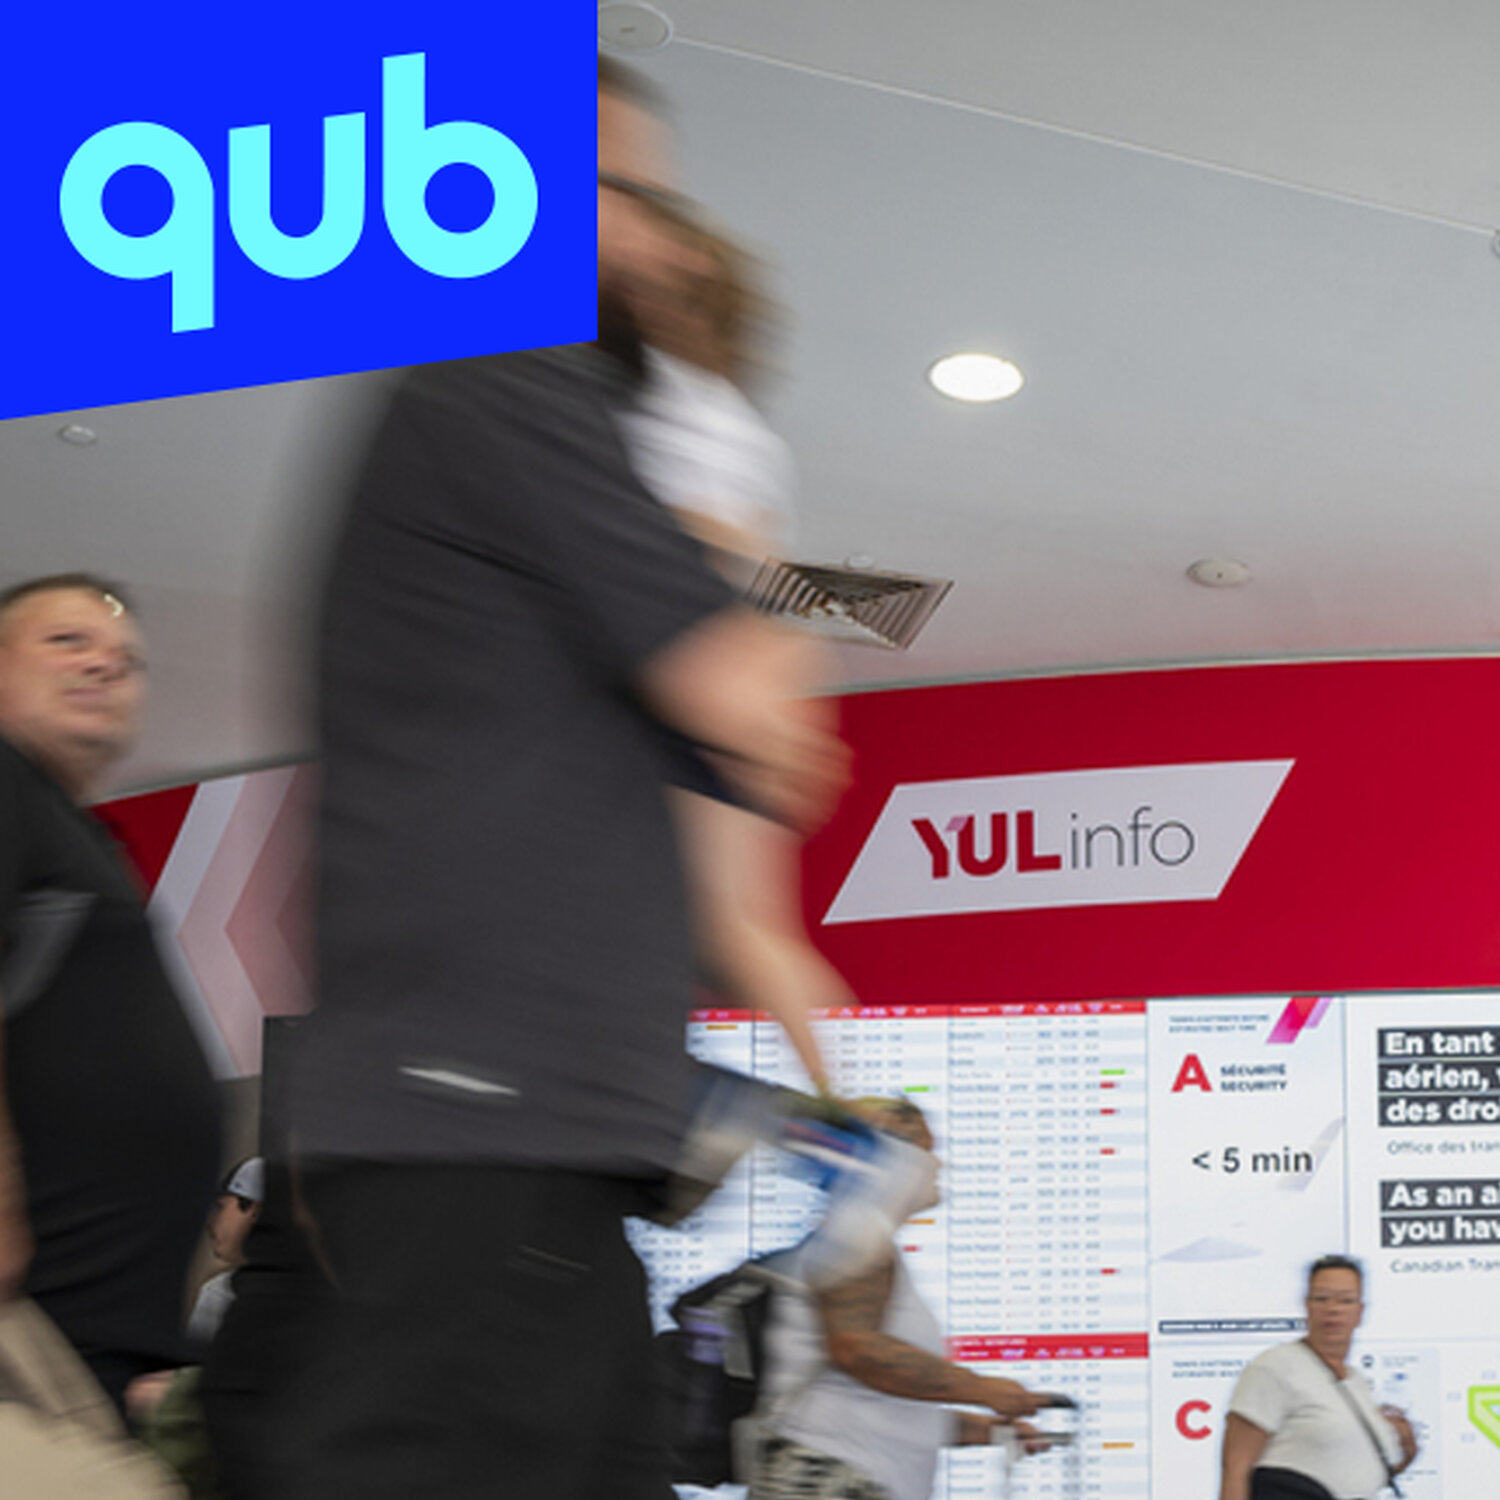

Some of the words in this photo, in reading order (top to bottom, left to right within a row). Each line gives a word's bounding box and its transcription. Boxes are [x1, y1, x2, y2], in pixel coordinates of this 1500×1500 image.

[1384, 1032, 1424, 1055] En
[1432, 1031, 1495, 1054] tant
[1171, 1054, 1213, 1093] A
[1385, 1066, 1489, 1092] aérien,
[1386, 1099, 1441, 1122] des
[1222, 1147, 1241, 1173] 5
[1252, 1146, 1313, 1172] min
[1387, 1140, 1434, 1156] Office
[1438, 1139, 1466, 1154] des
[1389, 1184, 1429, 1207] As
[1436, 1187, 1474, 1206] an
[1390, 1220, 1446, 1245] you
[1390, 1258, 1464, 1274] Canadian
[1175, 1400, 1212, 1440] C
